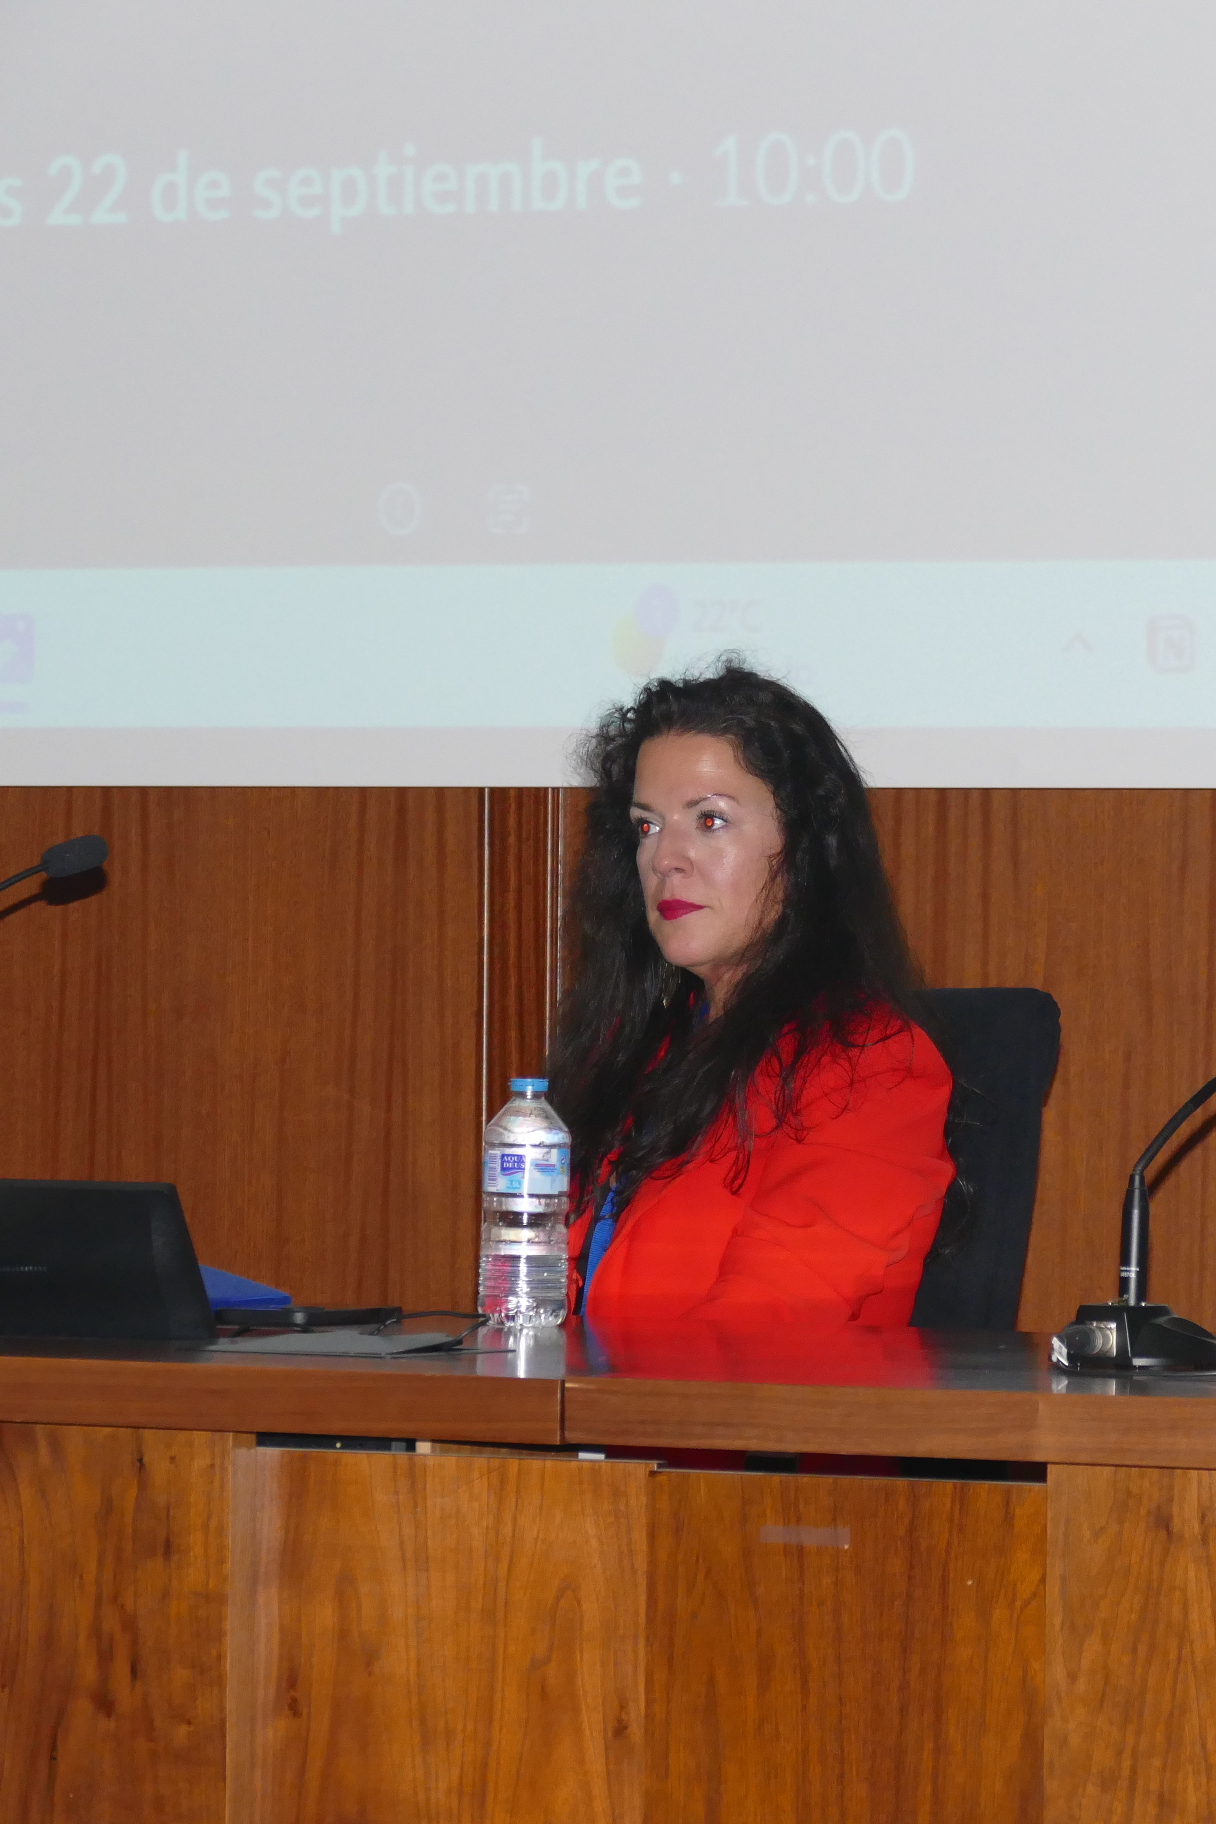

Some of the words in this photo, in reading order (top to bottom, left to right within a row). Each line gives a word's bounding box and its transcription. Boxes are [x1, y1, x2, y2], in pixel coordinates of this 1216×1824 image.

[46, 152, 129, 228] 22
[150, 148, 234, 223] de
[253, 137, 645, 236] septiembre
[715, 126, 917, 207] 10:00
